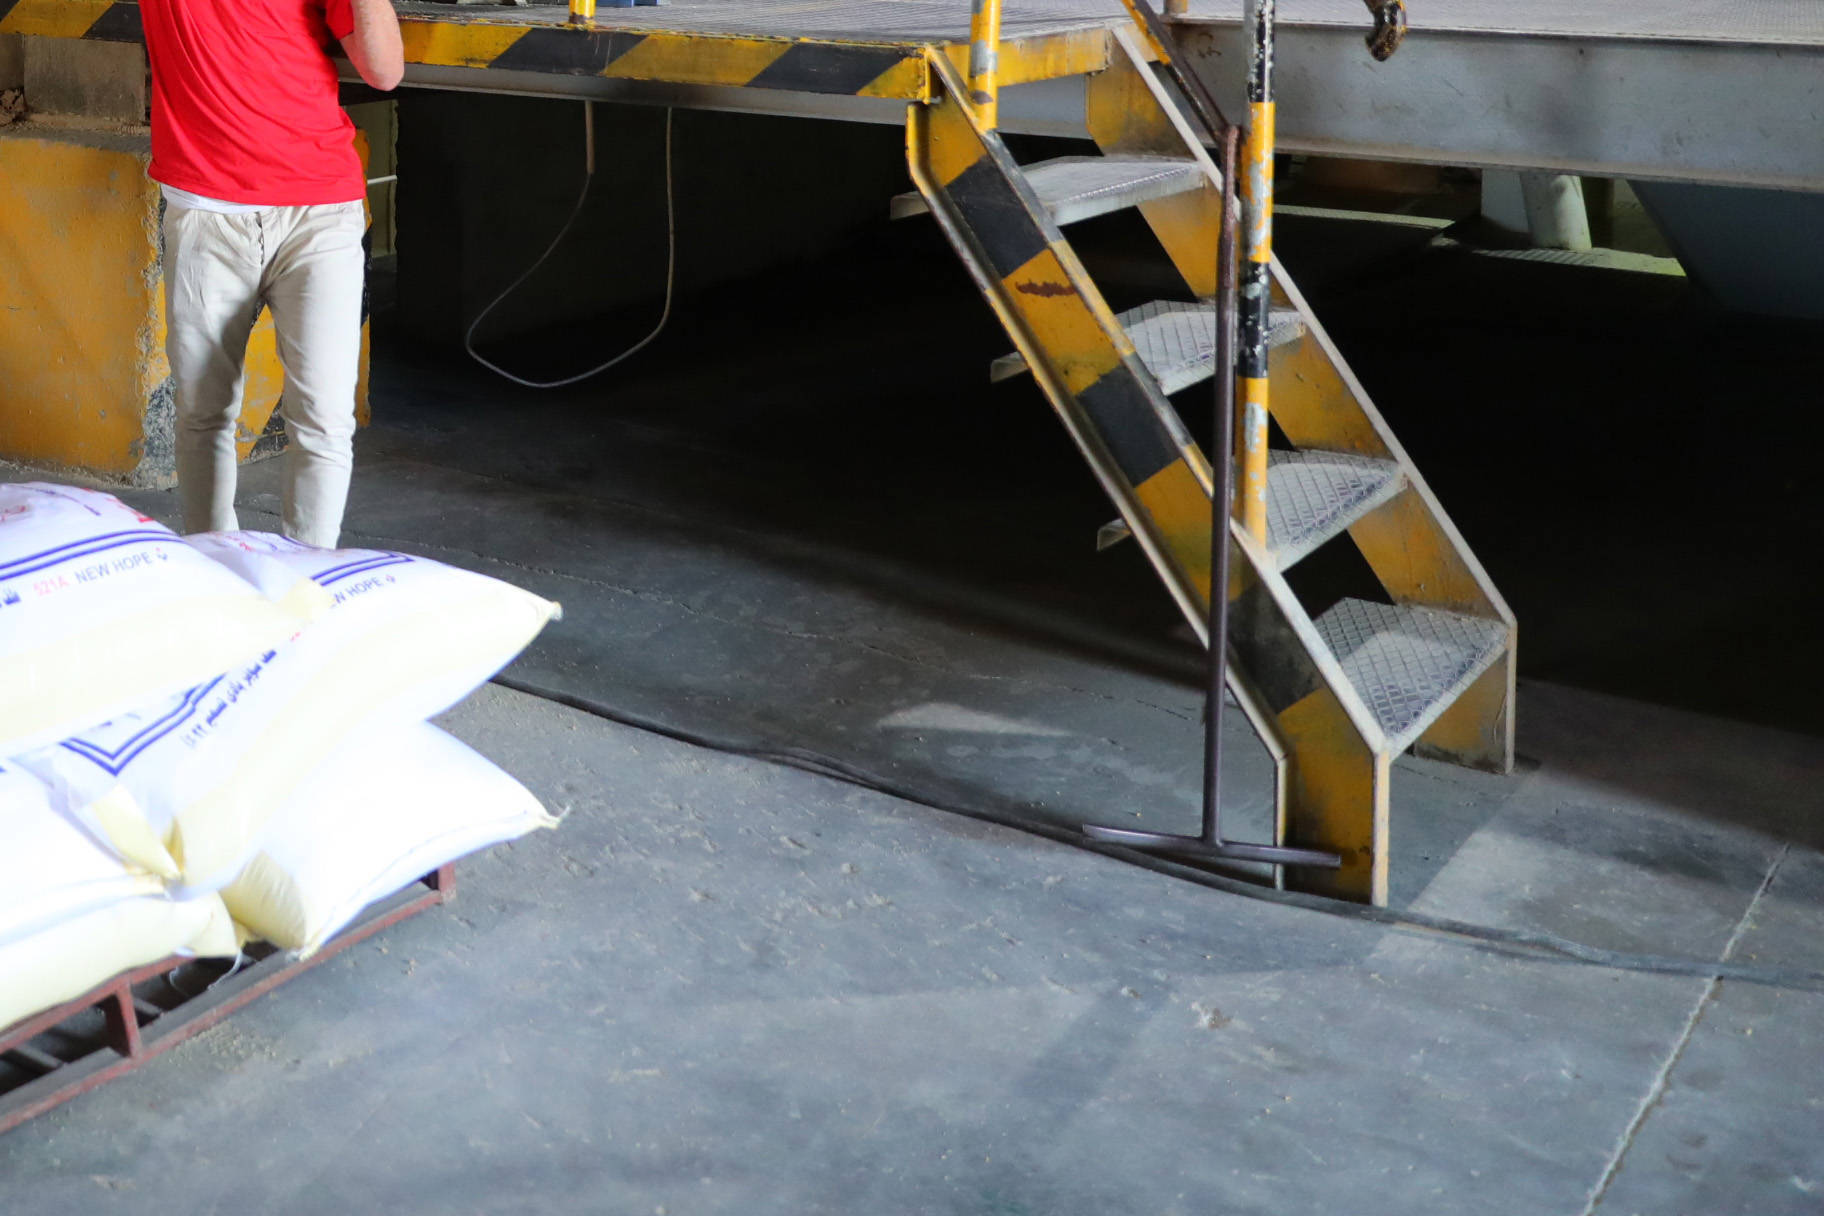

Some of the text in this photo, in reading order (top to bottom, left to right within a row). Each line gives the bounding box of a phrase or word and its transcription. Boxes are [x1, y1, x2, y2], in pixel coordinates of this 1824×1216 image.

[74, 563, 111, 584] NEW
[114, 551, 153, 571] HOPE
[348, 577, 382, 597] HOPE
